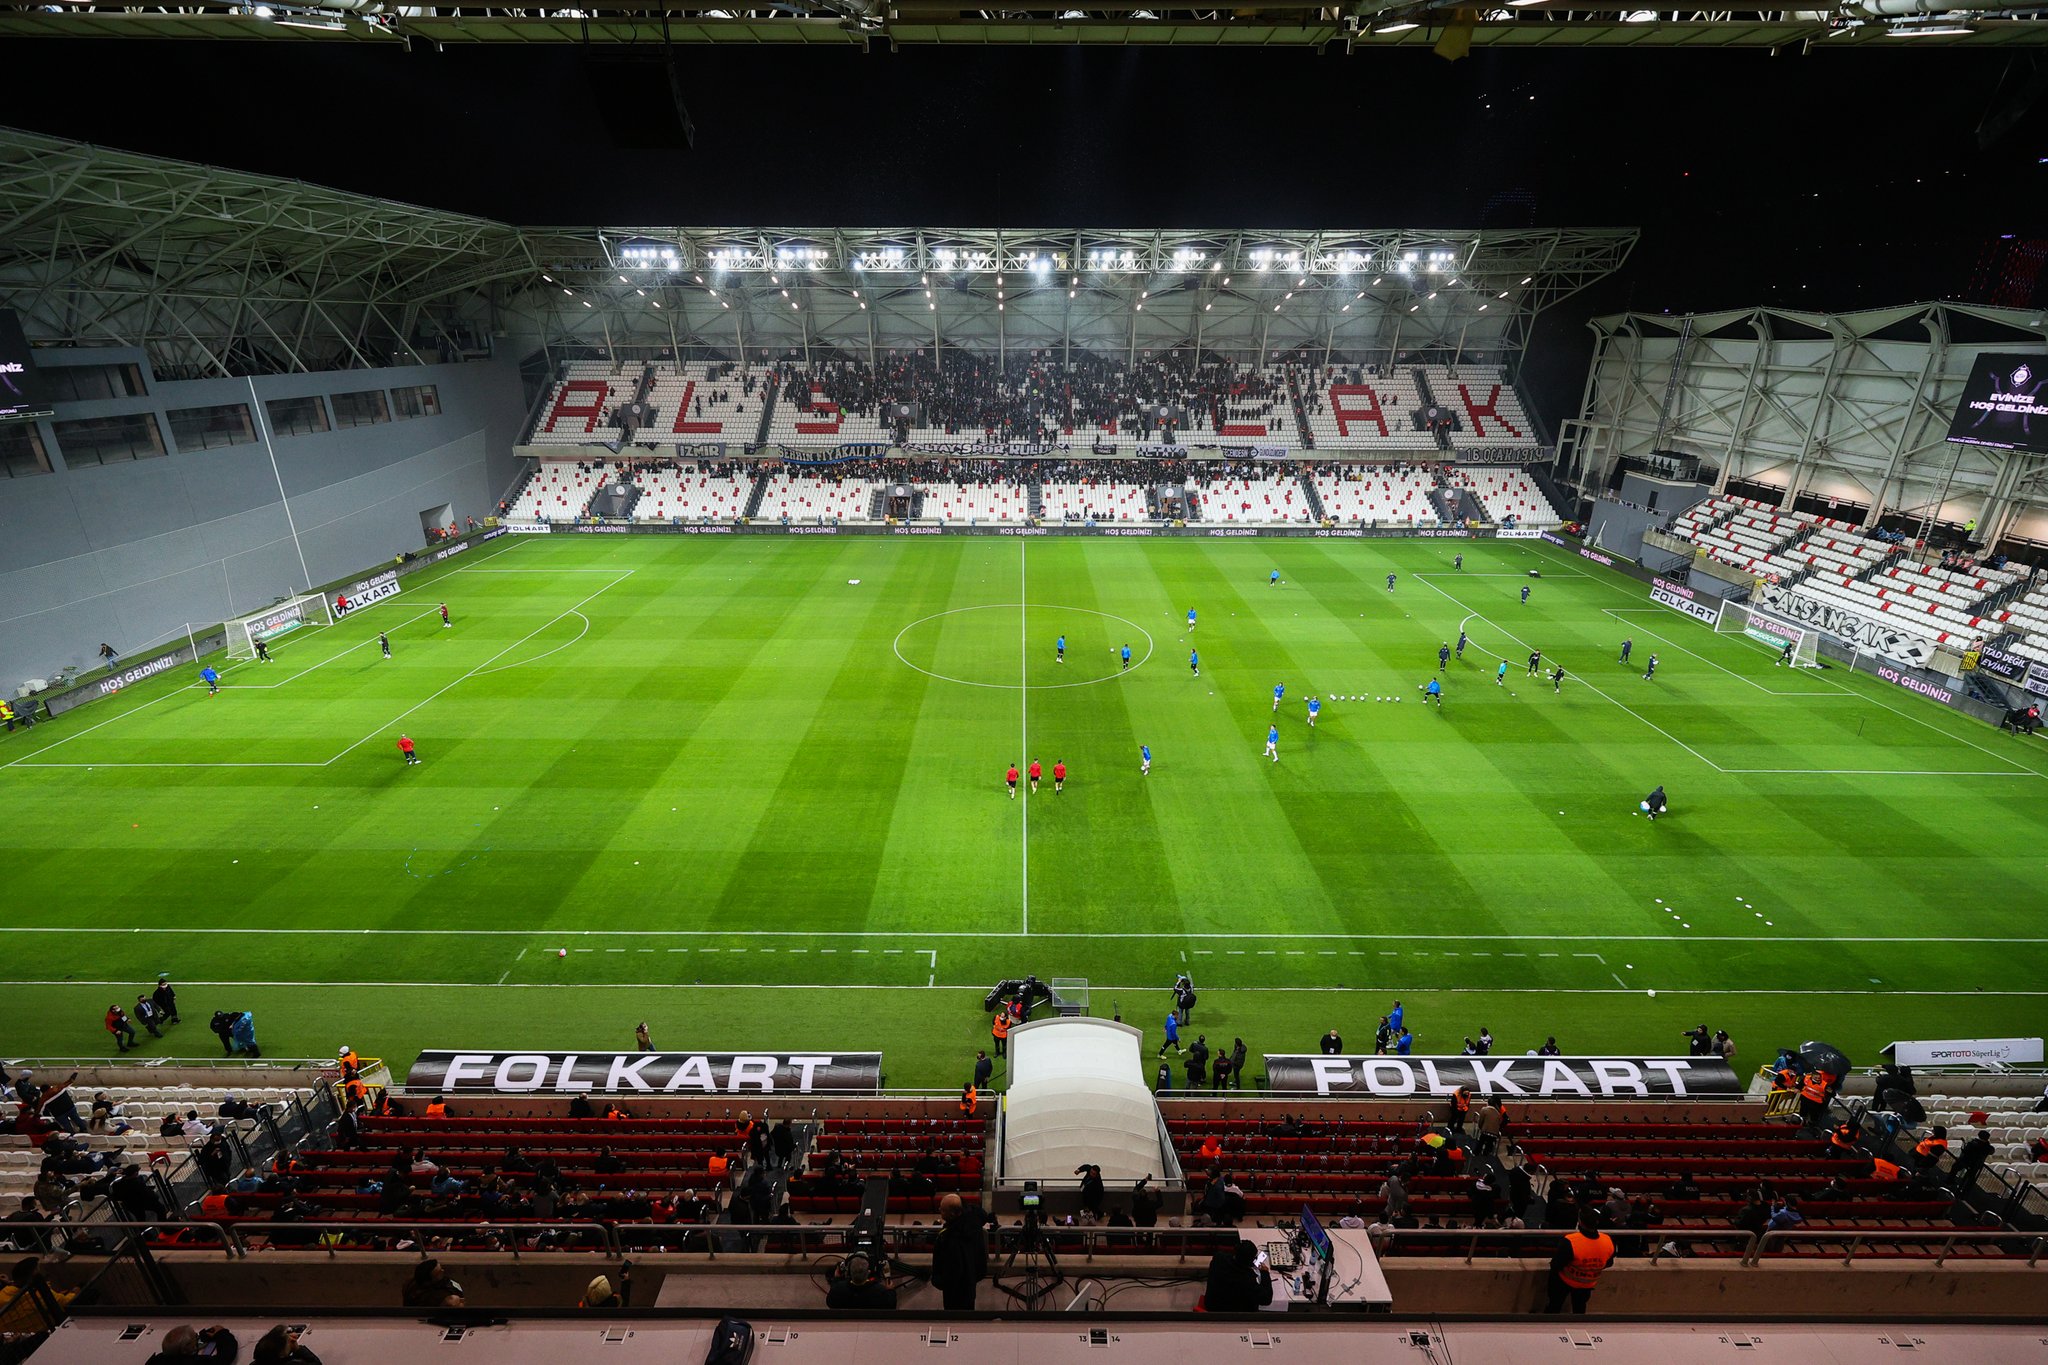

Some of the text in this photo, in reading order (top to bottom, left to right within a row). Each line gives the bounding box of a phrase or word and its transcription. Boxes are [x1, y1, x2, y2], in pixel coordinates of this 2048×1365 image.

[1990, 393, 2035, 404] EVİNİZE
[1969, 401, 1995, 411] HOŞ
[1137, 446, 1177, 457] ALTAY
[1466, 447, 1479, 461] 16
[1516, 447, 1545, 461] 1914
[356, 581, 370, 591] HOŞ
[1652, 577, 1665, 589] HOŞ
[335, 582, 398, 615] OLKART
[1651, 589, 1715, 620] FOLKART
[248, 621, 266, 634] HOŞ
[1750, 616, 1765, 628] HOŞ
[1775, 592, 1898, 653] ALSANCAK
[2002, 653, 2026, 668] DEĞİL
[100, 677, 123, 693] HOŞ
[1878, 666, 1952, 703] HOŞ GELDİNİZ!
[441, 1055, 833, 1093] FOLKART
[1310, 1059, 1692, 1097] FOLKART
[759, 1332, 765, 1340] 9
[1272, 1336, 1281, 1344] 16
